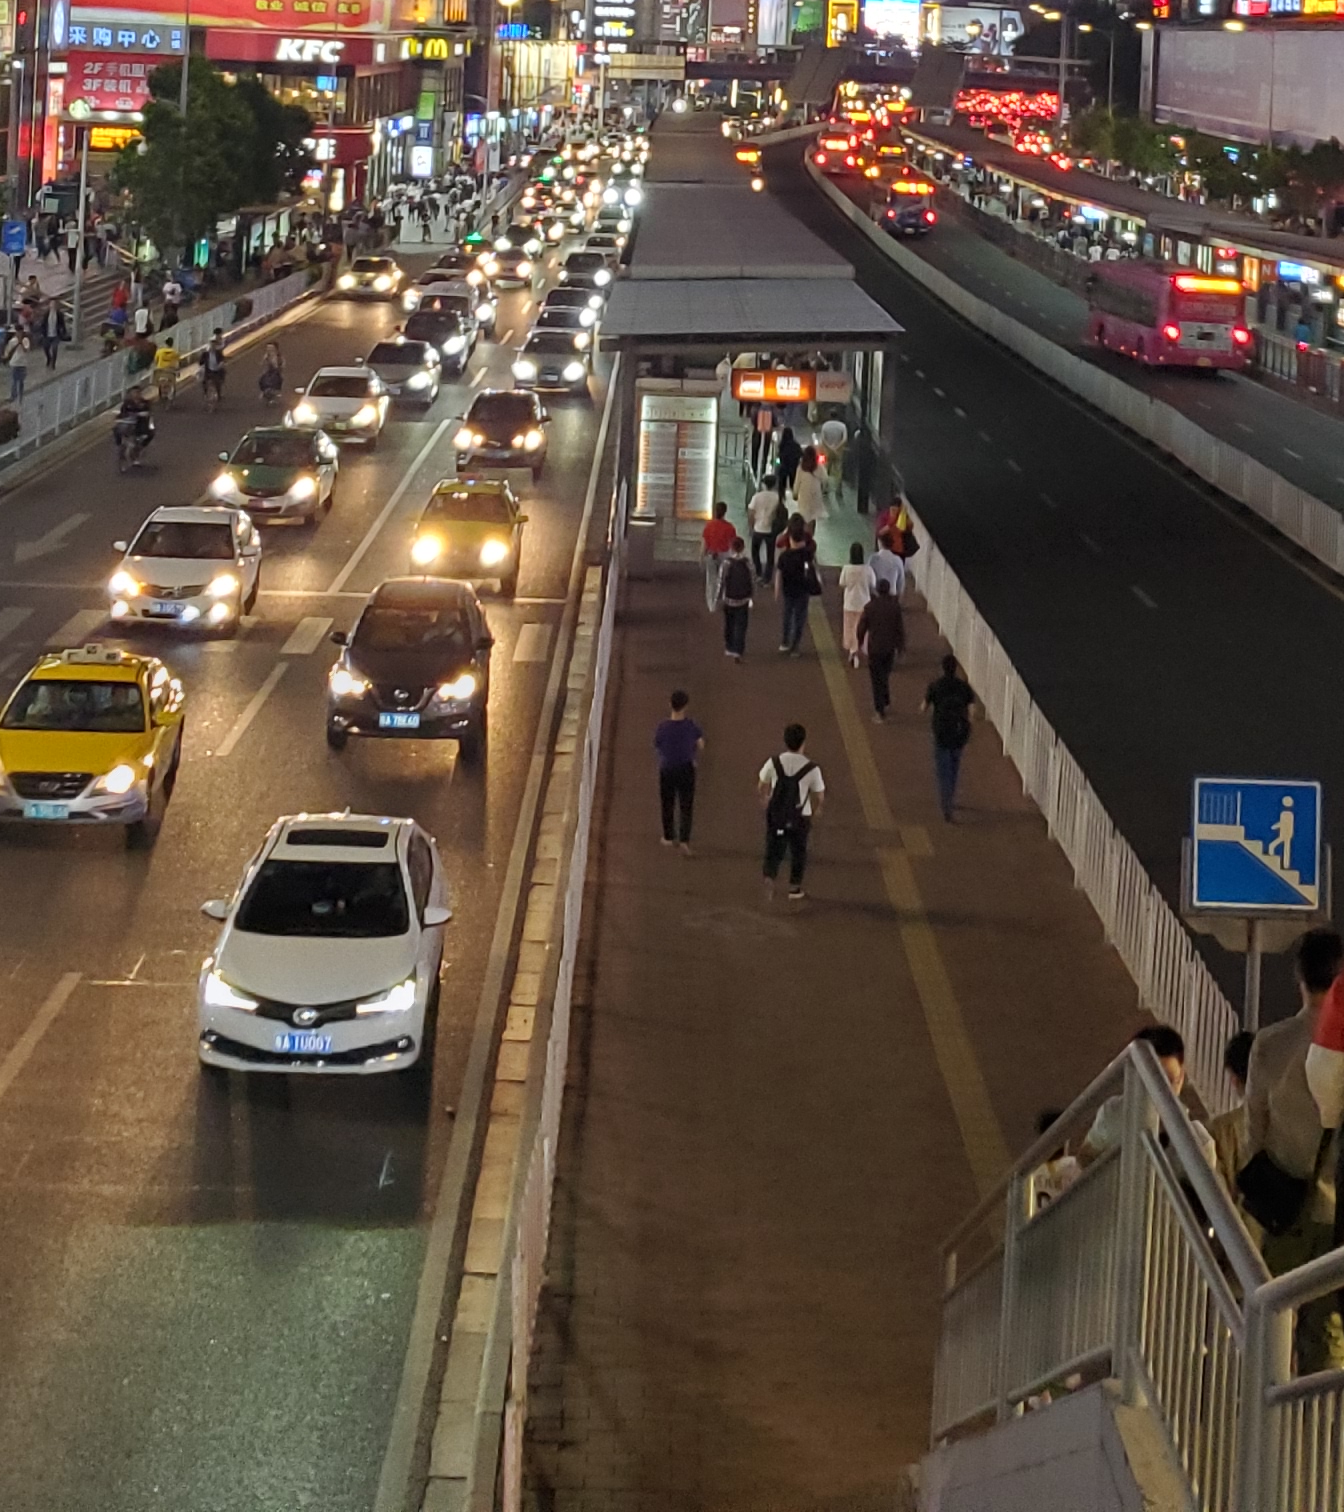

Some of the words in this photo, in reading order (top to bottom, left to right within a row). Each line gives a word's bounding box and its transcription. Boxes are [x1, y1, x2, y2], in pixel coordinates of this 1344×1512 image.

[69, 26, 160, 48] 采购中心
[275, 38, 345, 63] KFC
